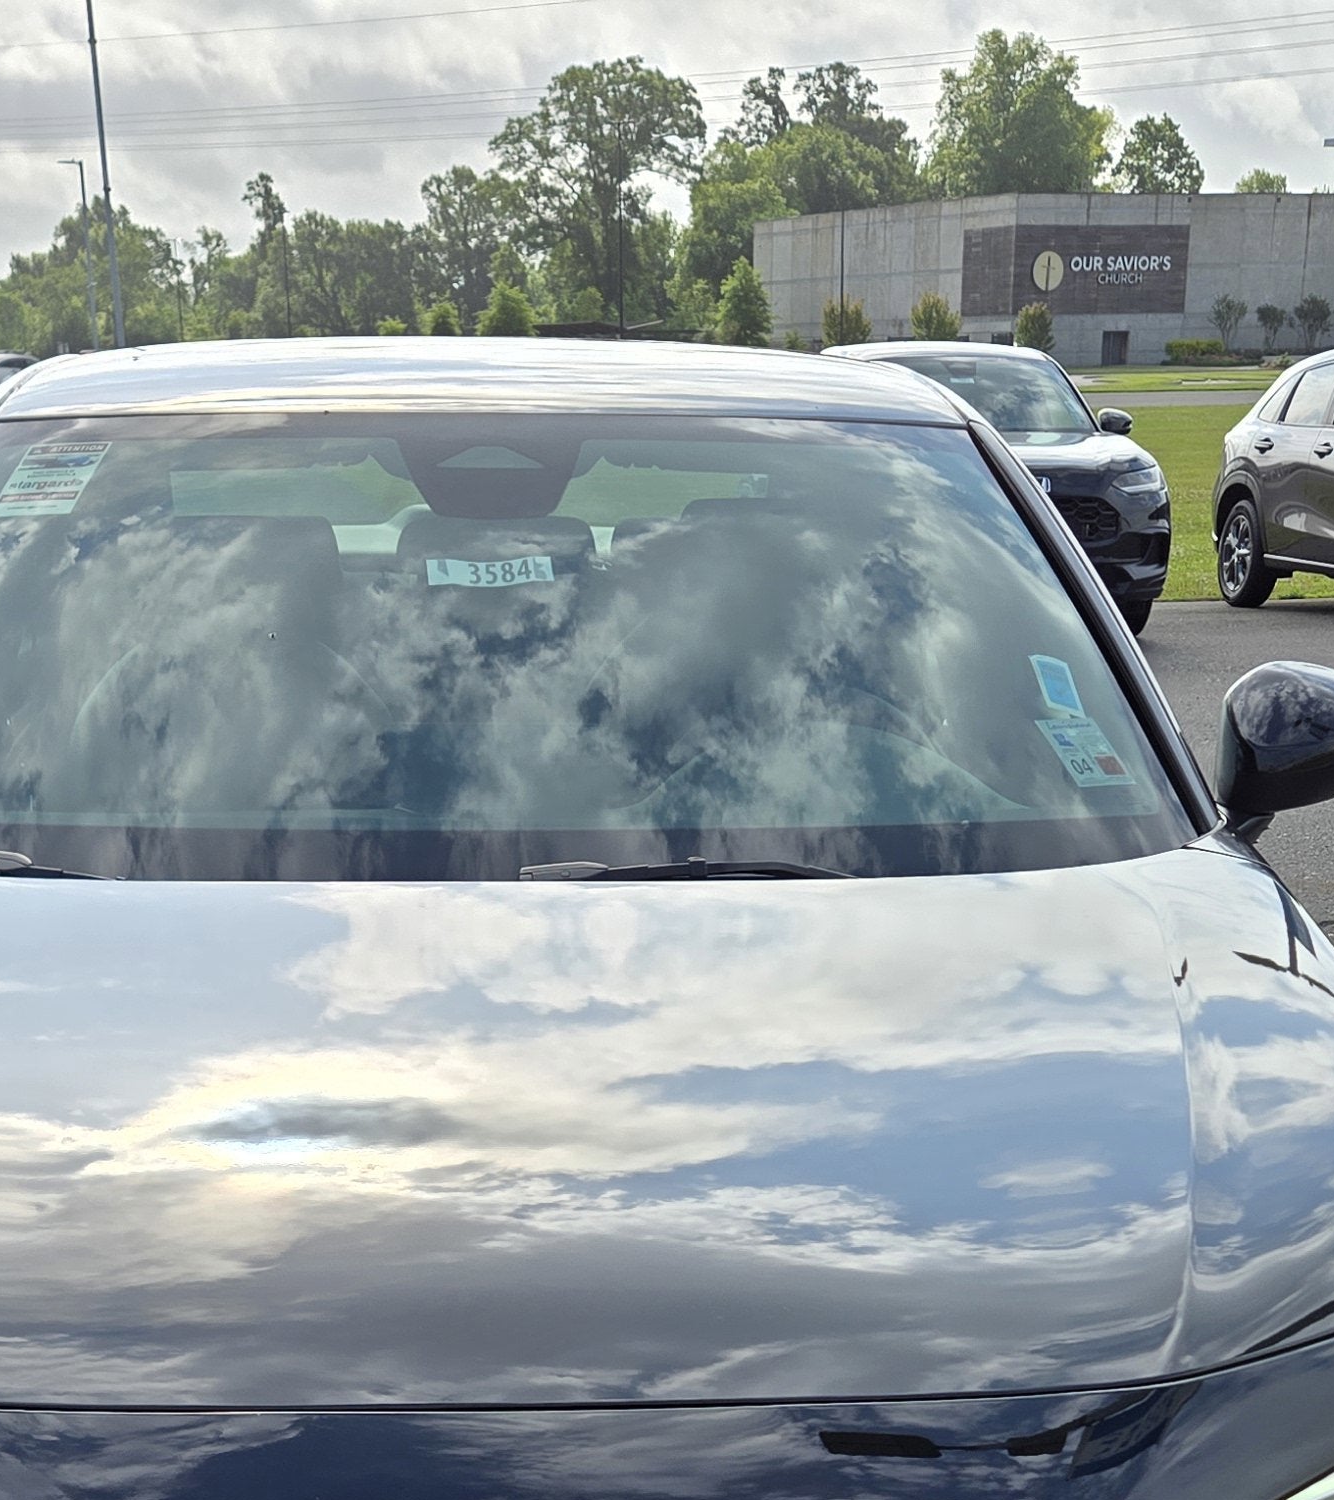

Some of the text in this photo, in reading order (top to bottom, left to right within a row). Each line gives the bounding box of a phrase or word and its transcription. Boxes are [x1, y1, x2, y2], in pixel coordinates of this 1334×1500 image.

[1071, 256, 1171, 271] OUR SAVIOR'S
[1098, 273, 1142, 284] CHURCH
[49, 445, 104, 453] ATTENTION
[468, 559, 532, 584] 3584
[1070, 758, 1094, 775] 04
